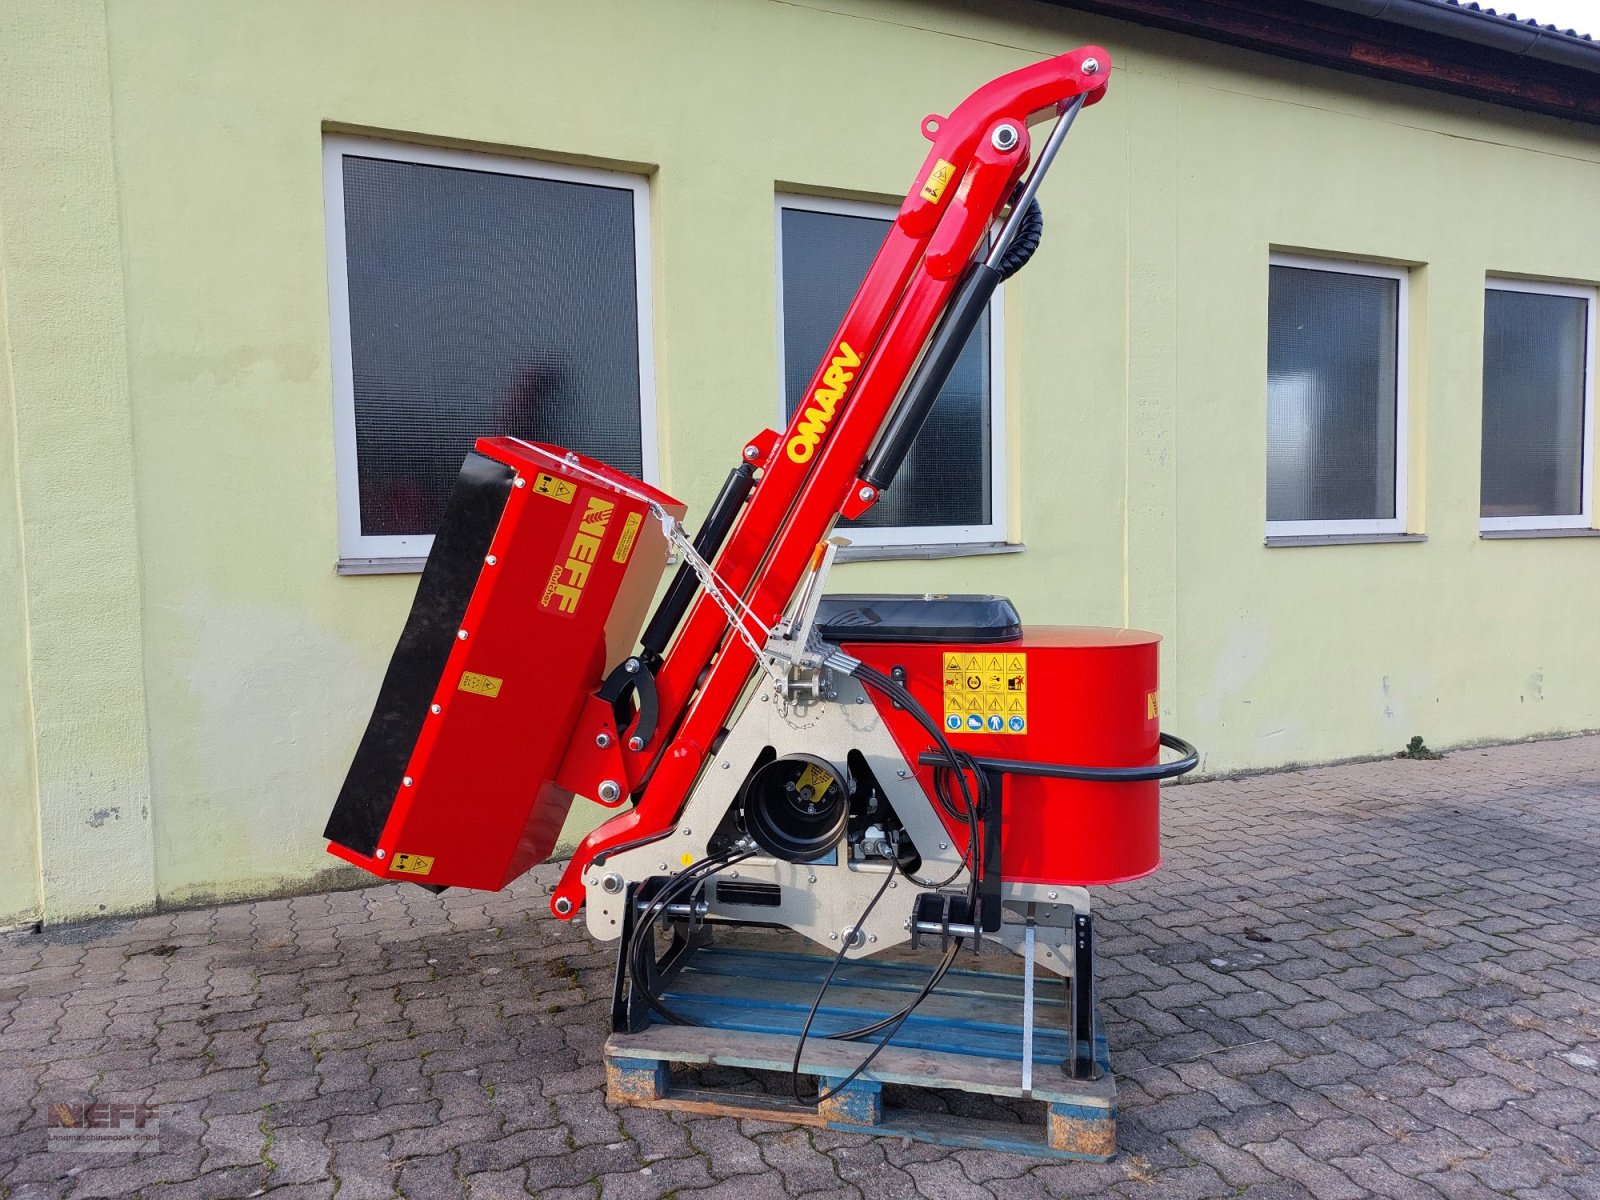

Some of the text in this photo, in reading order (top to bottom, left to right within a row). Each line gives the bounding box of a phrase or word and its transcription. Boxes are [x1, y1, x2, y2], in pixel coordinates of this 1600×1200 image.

[787, 341, 861, 464] OMARV
[541, 565, 562, 607] Mulcher
[555, 497, 615, 614] NEFF
